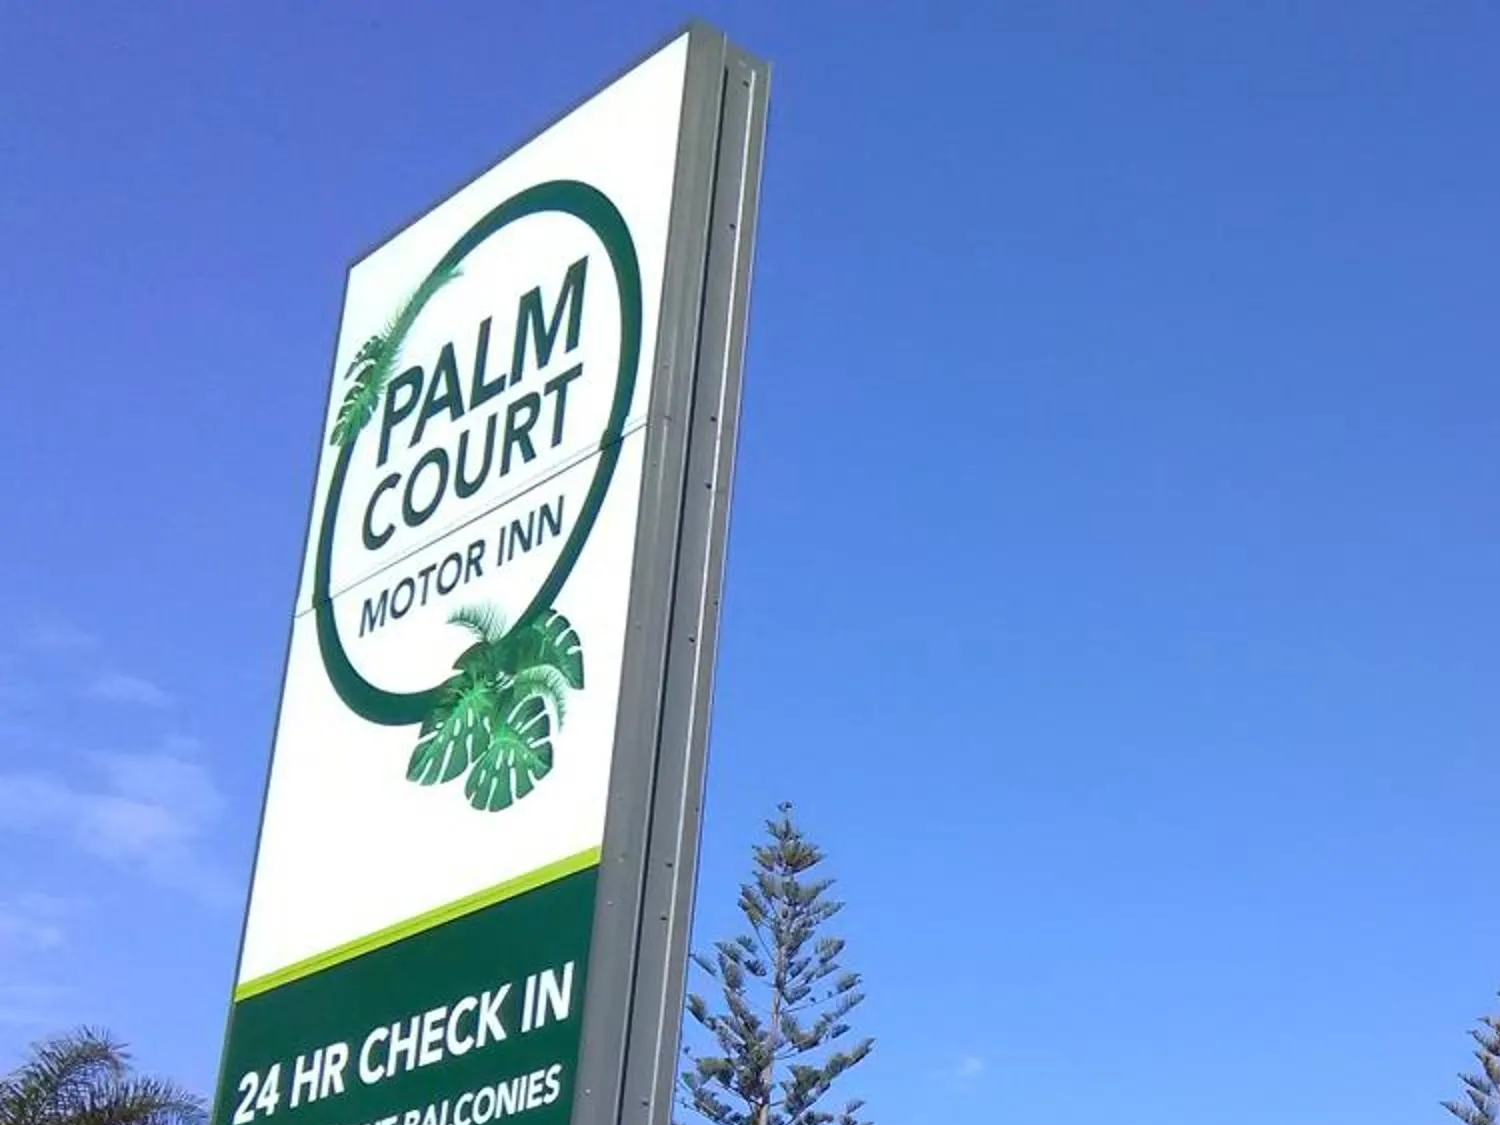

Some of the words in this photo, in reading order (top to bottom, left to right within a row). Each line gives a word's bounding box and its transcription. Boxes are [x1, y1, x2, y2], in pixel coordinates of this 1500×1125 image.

[376, 256, 588, 468] PALM
[363, 363, 583, 551] COURT
[359, 539, 485, 638] MOTOR
[496, 495, 565, 567] INN
[232, 1062, 280, 1125] 24
[290, 1042, 349, 1109] HR
[359, 983, 513, 1085] CHECK
[521, 961, 575, 1033] IN
